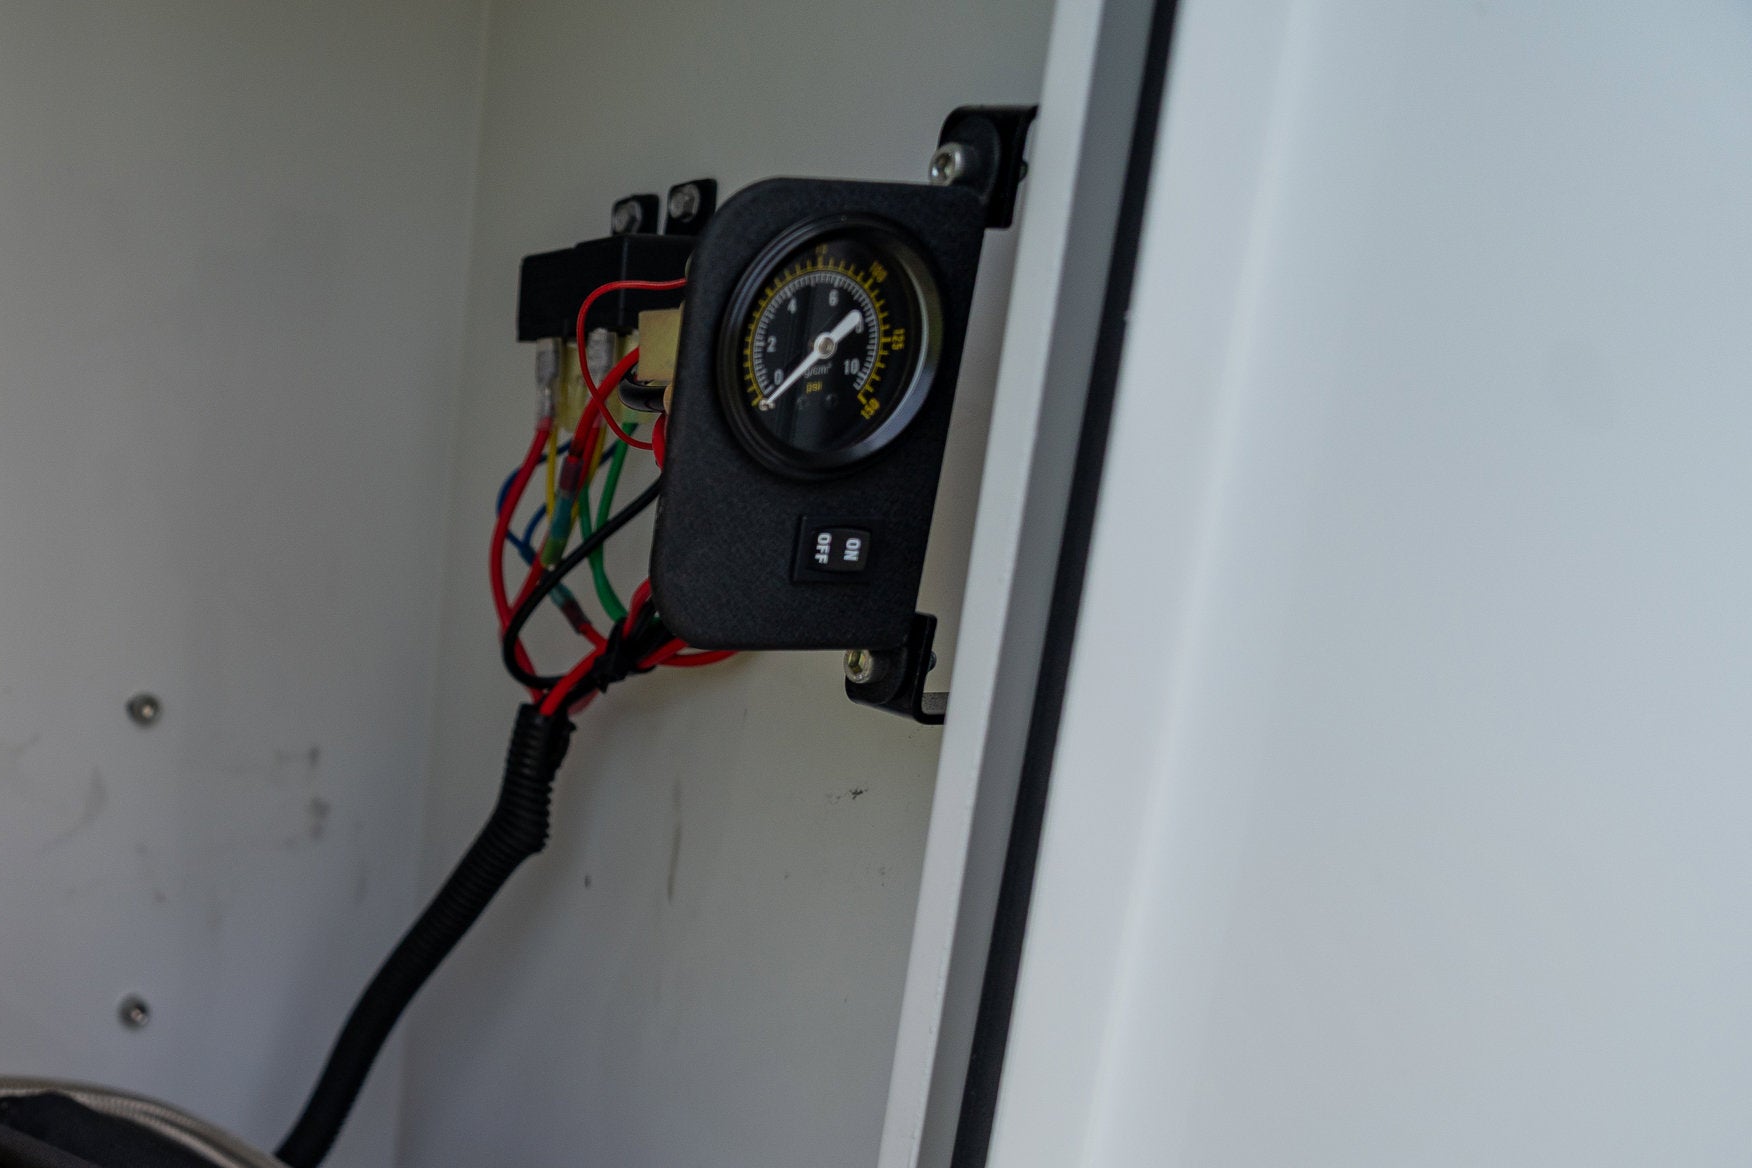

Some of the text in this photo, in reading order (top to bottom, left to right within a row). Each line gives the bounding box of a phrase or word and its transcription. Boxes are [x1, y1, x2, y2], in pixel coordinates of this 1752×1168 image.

[787, 296, 798, 315] 4
[828, 288, 839, 307] 6
[766, 335, 777, 353] 2
[891, 328, 905, 351] 125
[844, 358, 861, 375] 10
[773, 368, 784, 386] 0
[814, 532, 832, 564] OFF
[843, 537, 861, 562] ON
